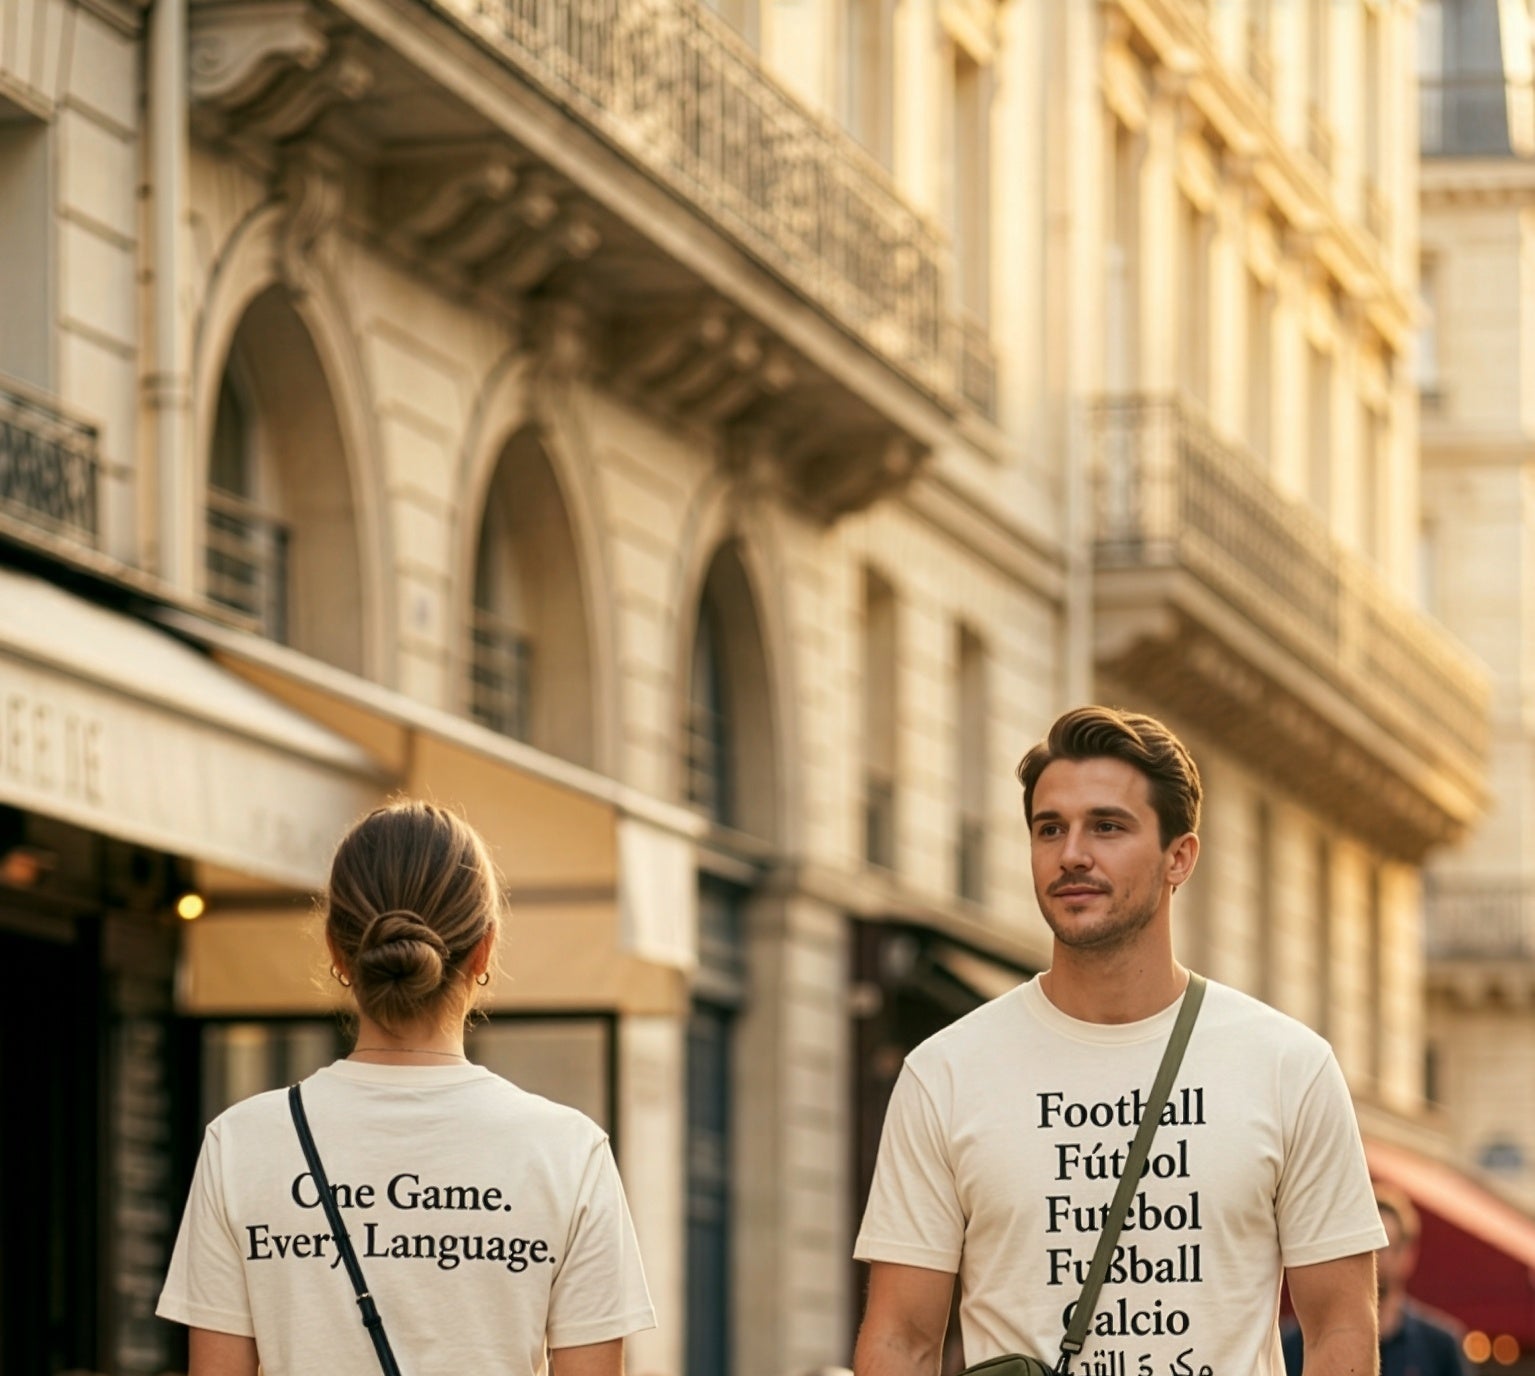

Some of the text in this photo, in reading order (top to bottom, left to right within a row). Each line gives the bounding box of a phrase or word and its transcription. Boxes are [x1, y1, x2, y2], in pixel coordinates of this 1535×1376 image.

[1036, 1087, 1206, 1128] Football
[1054, 1139, 1190, 1180] Fútol
[292, 1172, 512, 1212] One Game.
[1045, 1191, 1202, 1233] Futebol
[363, 1223, 556, 1273] Language.
[1046, 1244, 1203, 1285] Fußball
